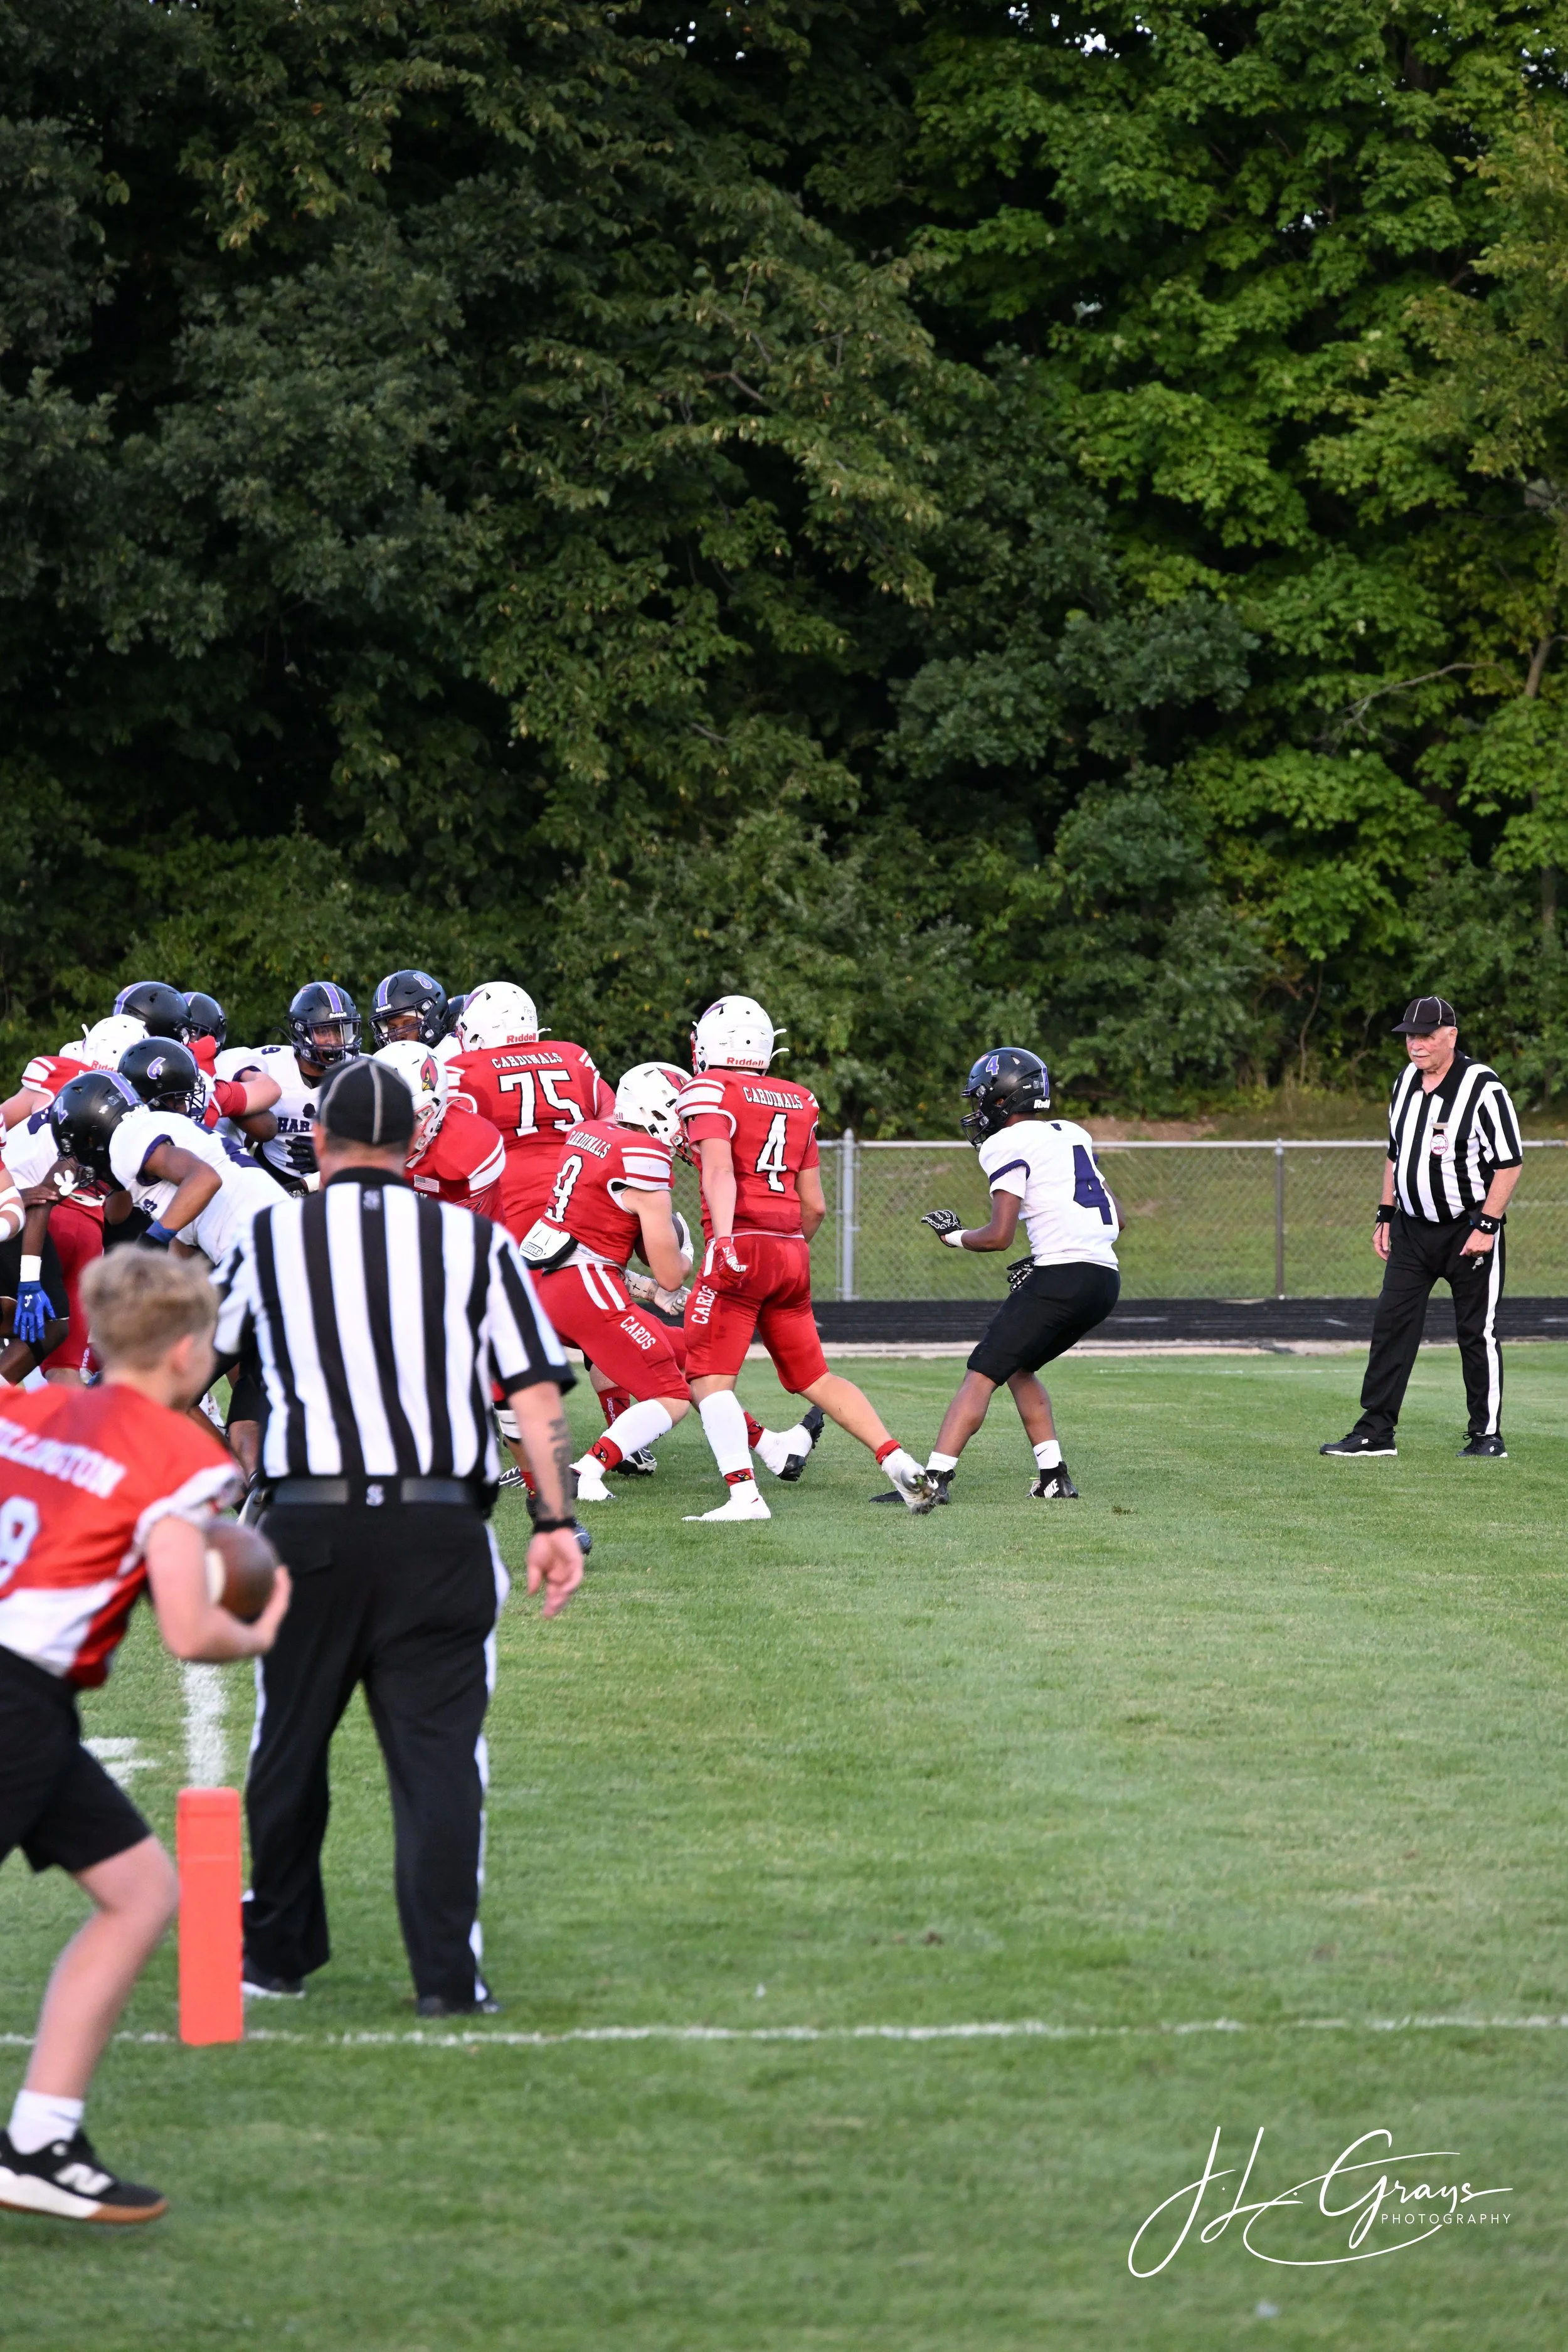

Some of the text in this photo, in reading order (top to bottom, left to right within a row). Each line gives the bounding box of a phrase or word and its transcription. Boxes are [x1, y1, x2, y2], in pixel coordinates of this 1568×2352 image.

[413, 973, 433, 989] 8
[506, 1033, 536, 1044] Riddell
[147, 1056, 166, 1079] 6
[491, 1052, 563, 1069] CARDINALS
[726, 1057, 764, 1067] Riddell
[985, 1055, 999, 1076] 4
[497, 1069, 585, 1137] 75
[743, 1086, 803, 1110] CARDINALS
[566, 1130, 612, 1159] CARDINALS
[755, 1111, 788, 1194] 4
[544, 1153, 584, 1224] 9
[1073, 1145, 1113, 1225] 4
[620, 1315, 656, 1350] CARDS
[1044, 1478, 1059, 1499] NIKE
